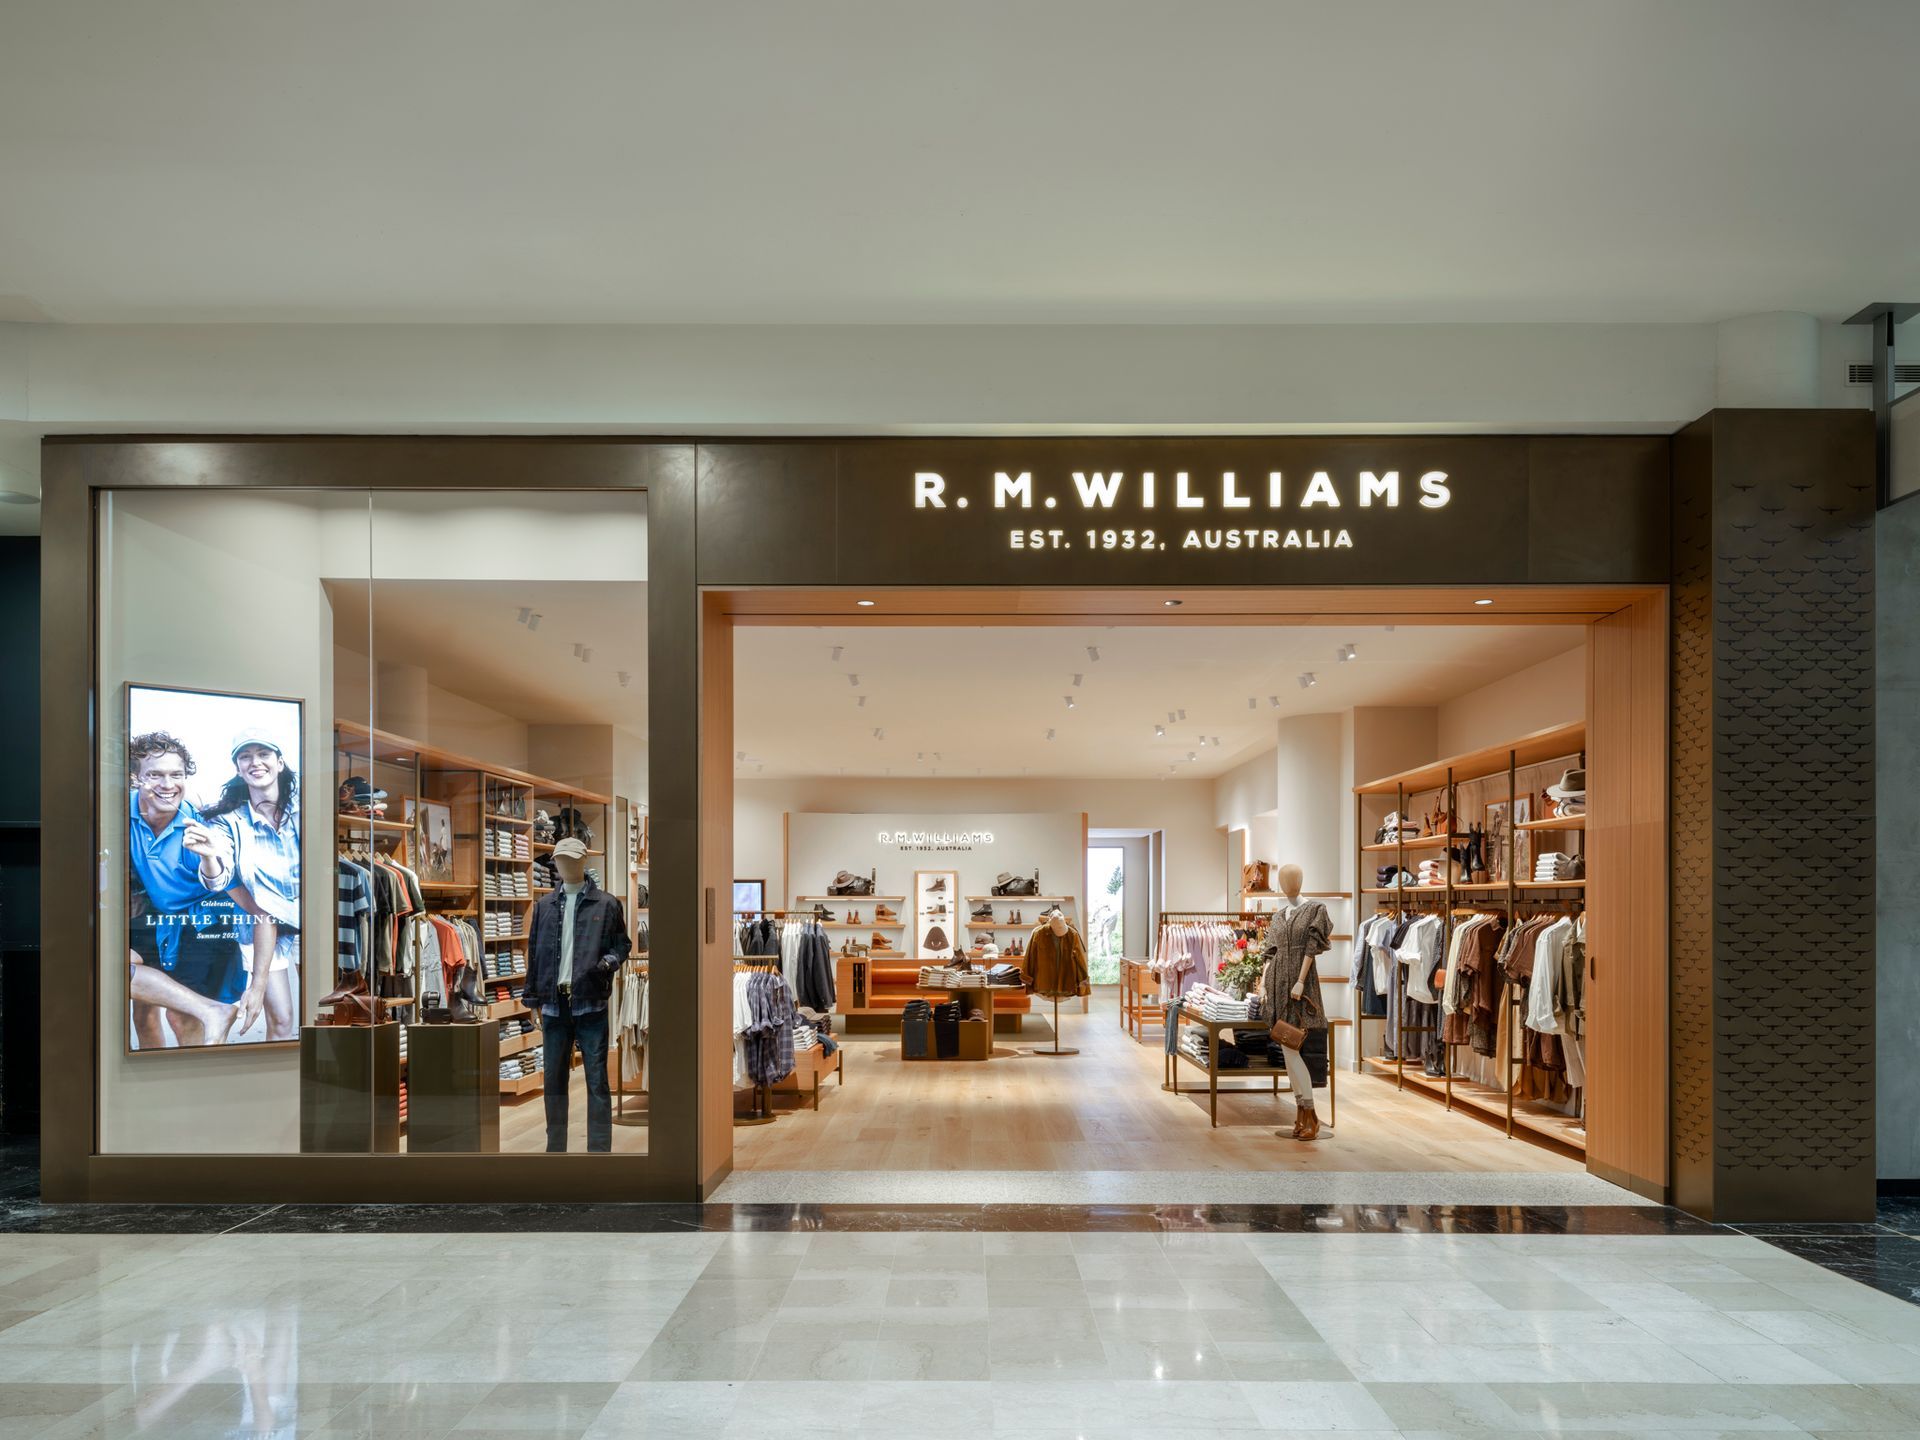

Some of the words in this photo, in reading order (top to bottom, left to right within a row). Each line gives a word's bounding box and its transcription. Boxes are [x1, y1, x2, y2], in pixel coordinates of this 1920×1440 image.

[1010, 529, 1071, 549] EST.
[1086, 529, 1166, 551] 1932,
[1182, 529, 1354, 549] AUSTRALIA
[200, 900, 235, 909] Celebrating
[146, 914, 213, 926] LITTLE
[220, 914, 287, 926] THINGS
[196, 932, 221, 940] Summer
